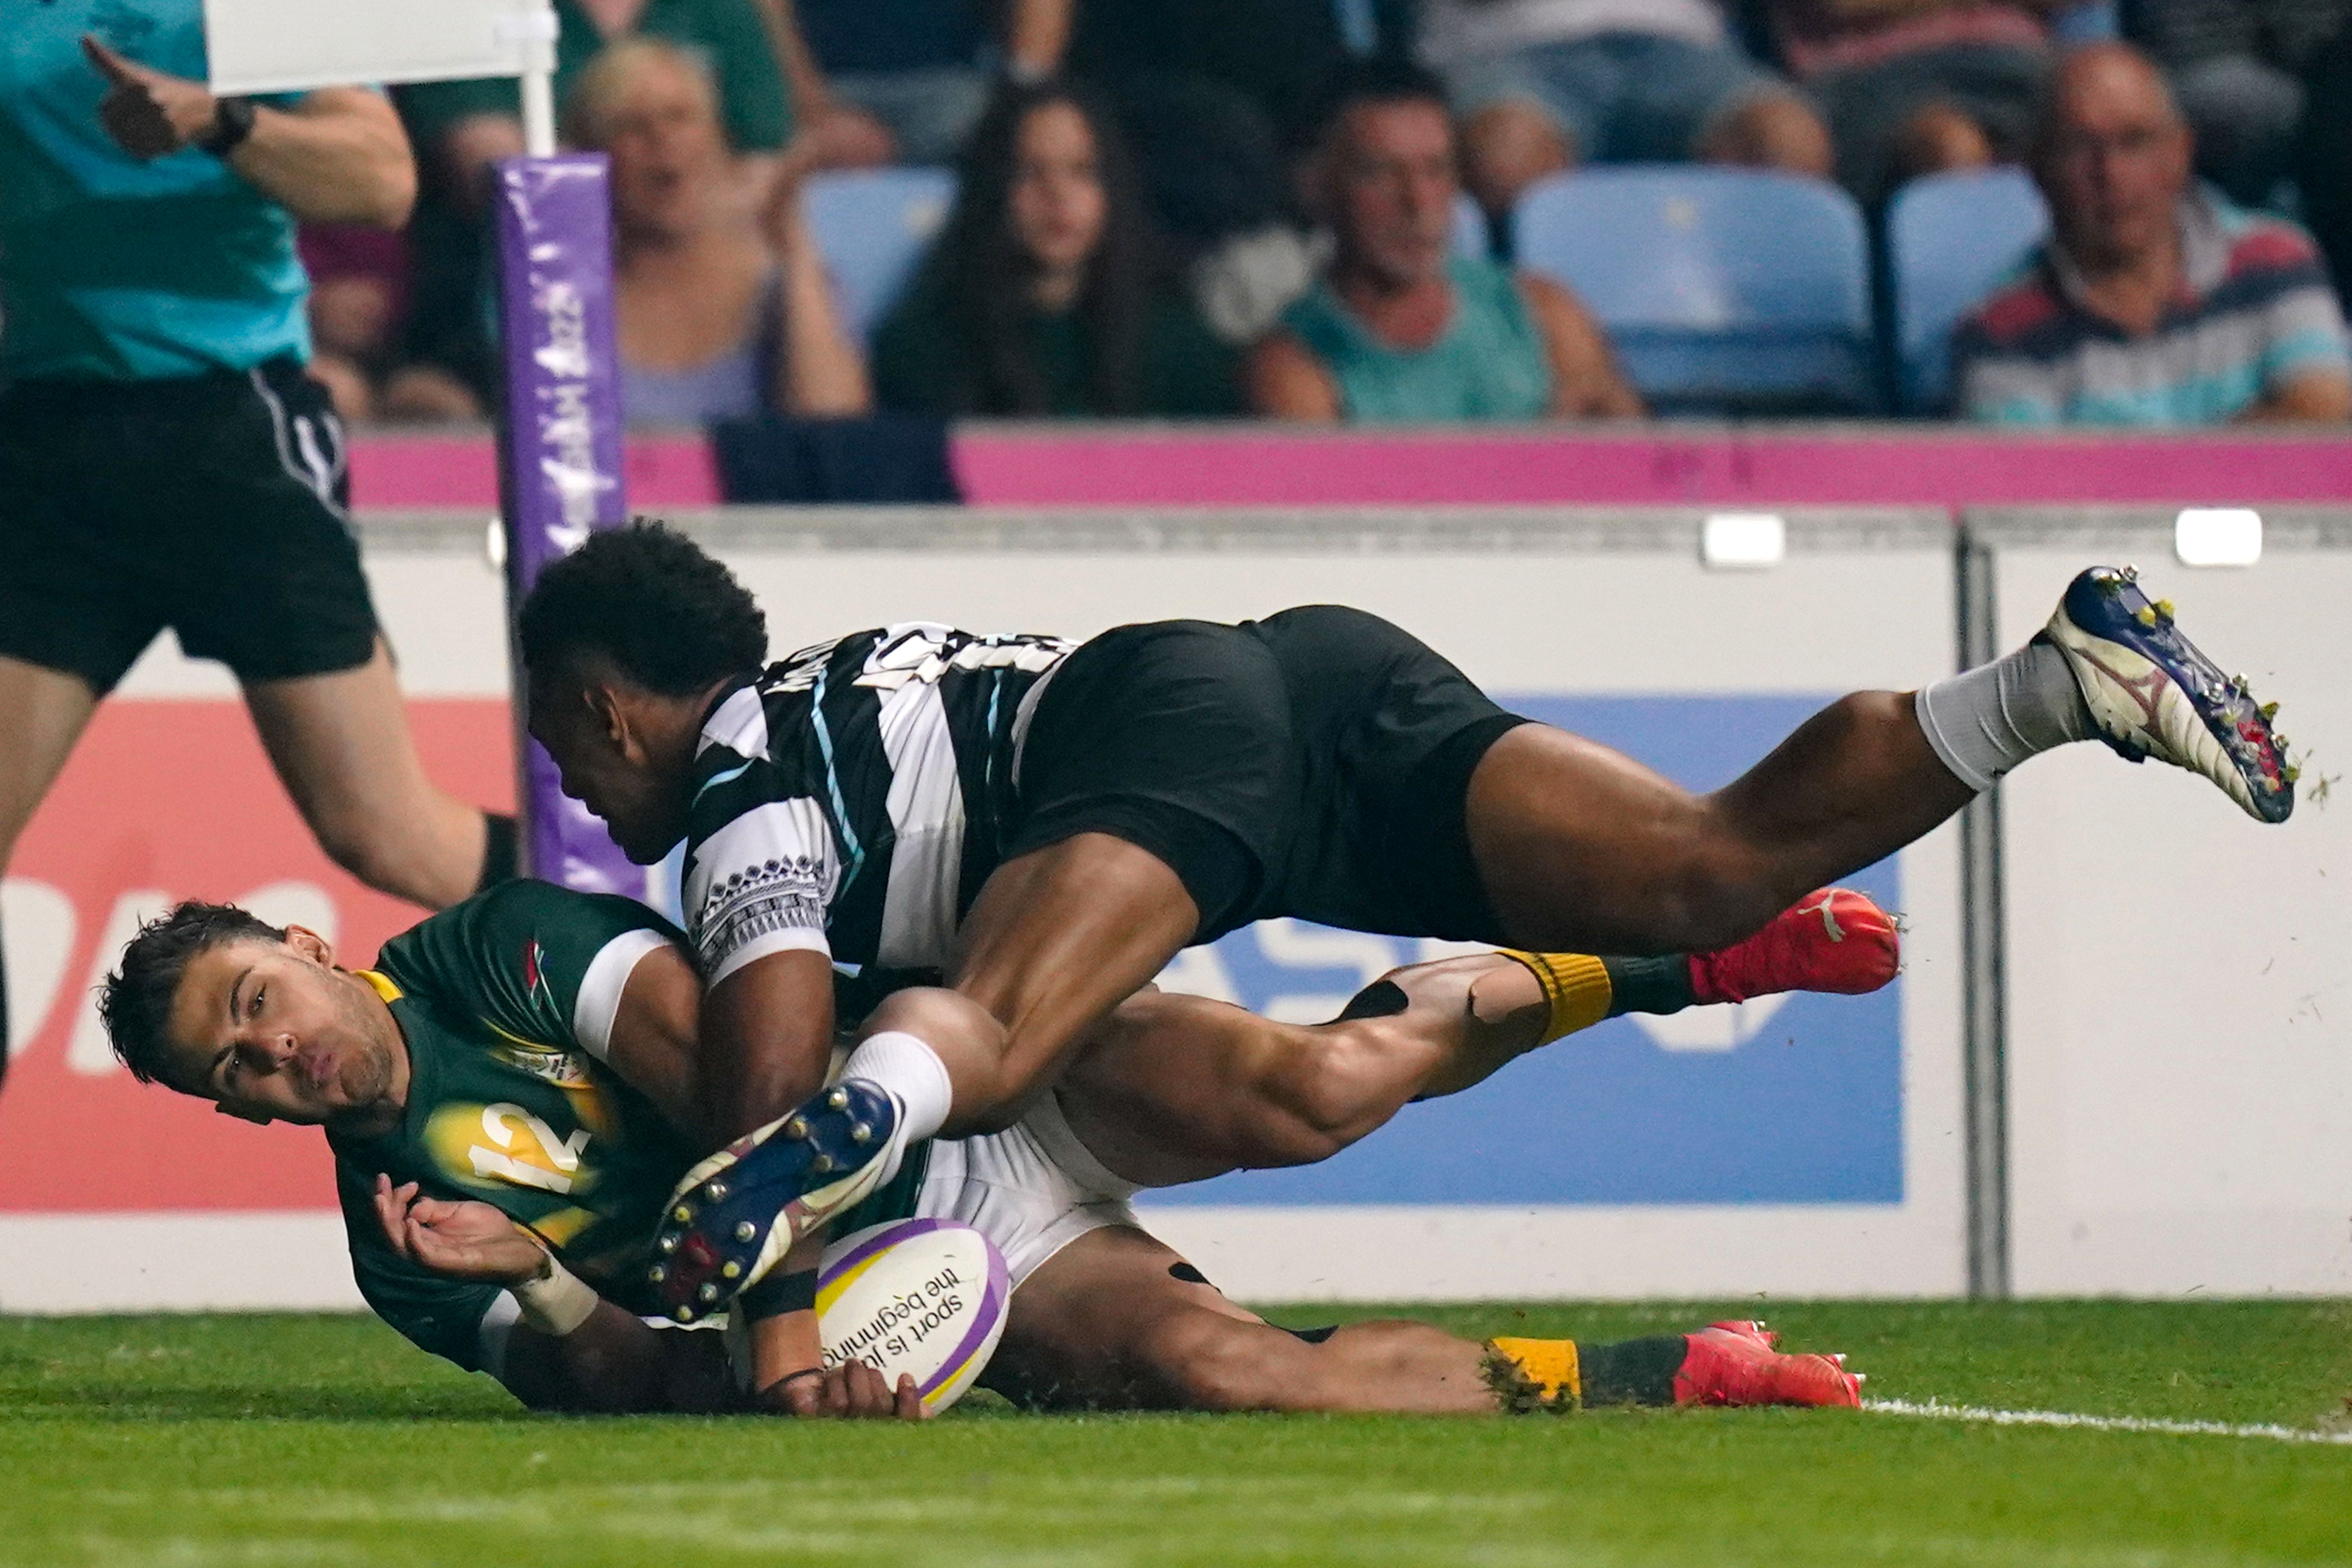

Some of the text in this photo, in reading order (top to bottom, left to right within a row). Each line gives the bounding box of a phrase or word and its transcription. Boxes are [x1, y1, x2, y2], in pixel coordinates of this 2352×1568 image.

[468, 1102, 592, 1194] 12
[925, 1268, 960, 1297] the
[908, 1294, 963, 1343] sport
[886, 1335, 910, 1356] is
